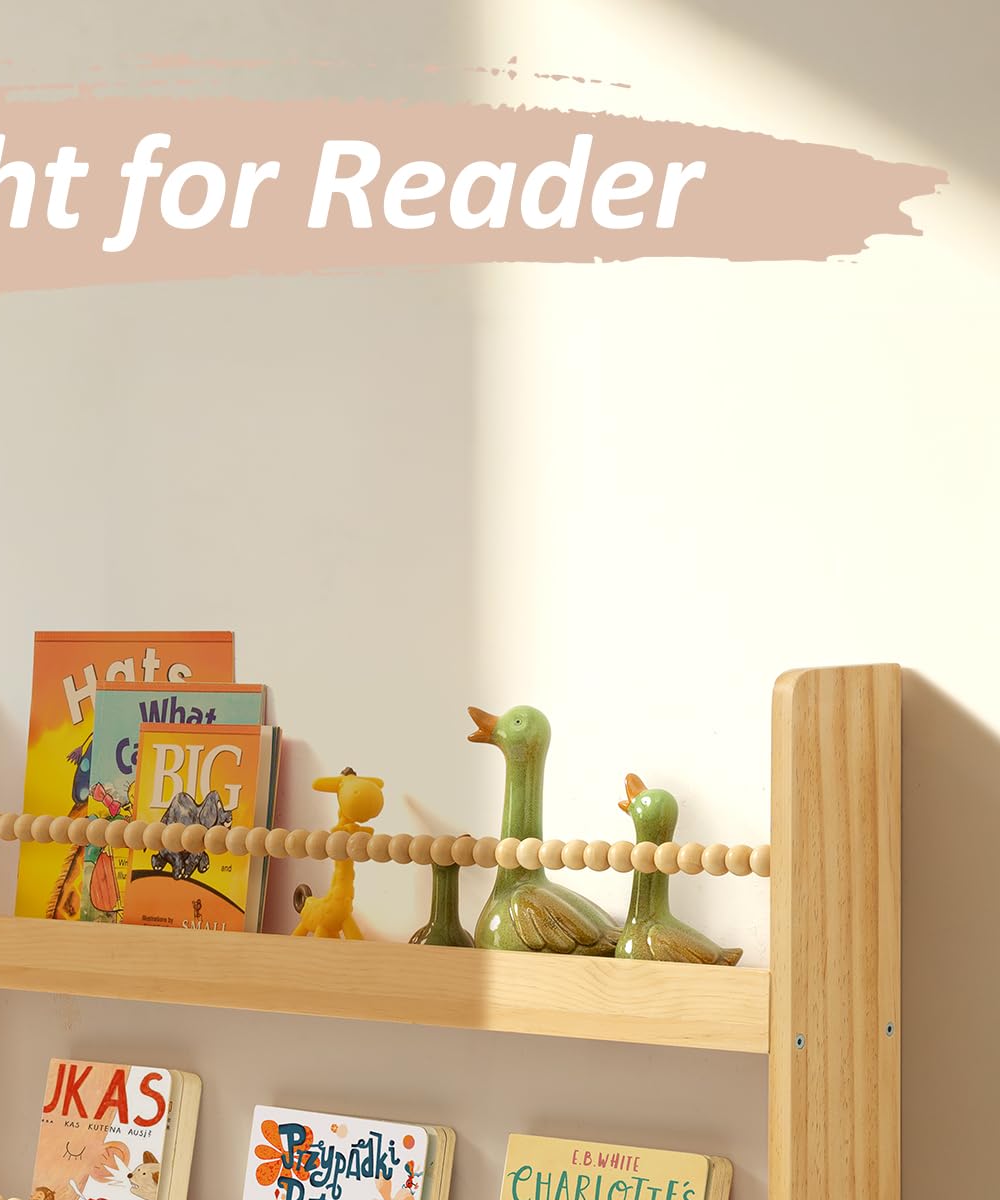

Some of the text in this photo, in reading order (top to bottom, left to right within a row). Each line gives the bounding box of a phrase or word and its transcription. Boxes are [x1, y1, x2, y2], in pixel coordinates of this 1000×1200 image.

[139, 696, 217, 725] What
[149, 743, 243, 811] BIG
[221, 864, 233, 872] and
[64, 1120, 80, 1129] KAS
[88, 1123, 122, 1134] KUTENA
